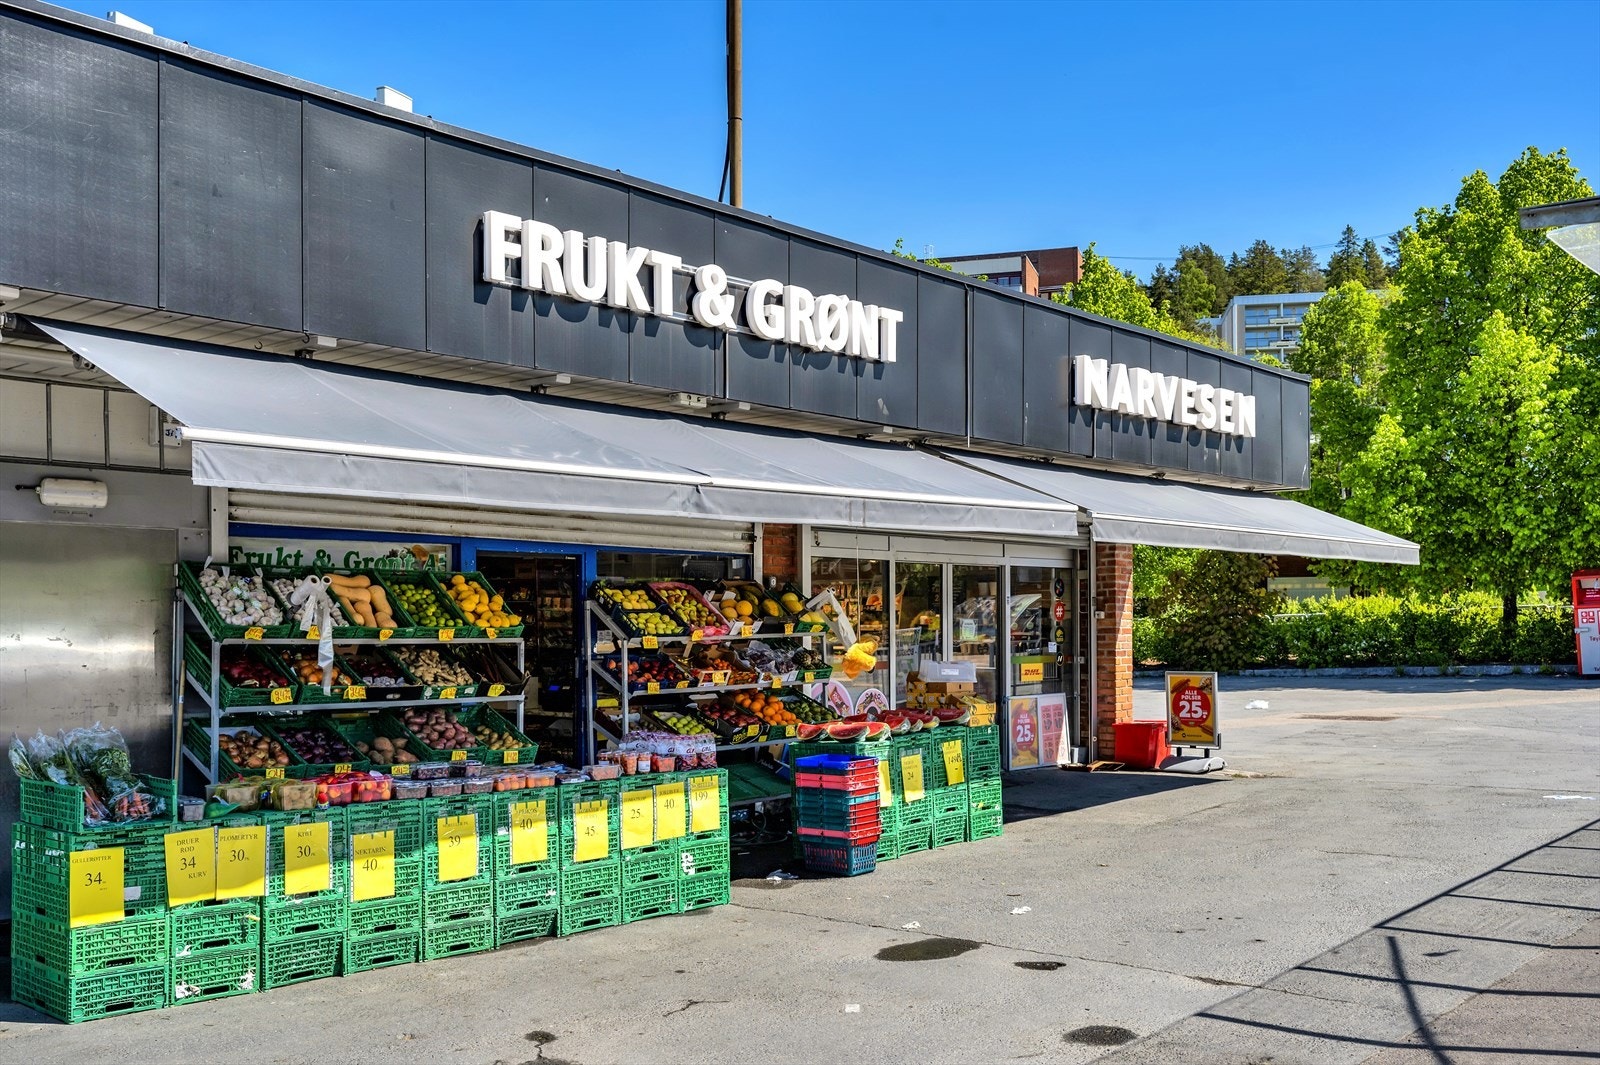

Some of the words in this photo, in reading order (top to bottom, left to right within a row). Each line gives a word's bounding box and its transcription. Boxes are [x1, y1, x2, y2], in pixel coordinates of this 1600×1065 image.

[482, 209, 683, 318] FRUKT
[692, 263, 736, 330] &
[745, 277, 905, 365] GRØNT
[1073, 353, 1257, 440] NARVESEN
[228, 545, 304, 567] Frukt
[313, 548, 336, 569] &
[694, 790, 708, 801] 199
[664, 798, 675, 809] 40
[631, 808, 641, 819] 25
[519, 818, 533, 830] 40
[585, 825, 595, 837] 45
[176, 837, 200, 847] DRUER
[448, 834, 461, 847] 39
[229, 849, 245, 863] 30
[296, 845, 311, 859] 30
[354, 847, 387, 855] NEKTARIN
[179, 856, 197, 871] 34
[362, 858, 378, 872] 40
[84, 871, 102, 887] 34
[188, 871, 207, 879] KURV
